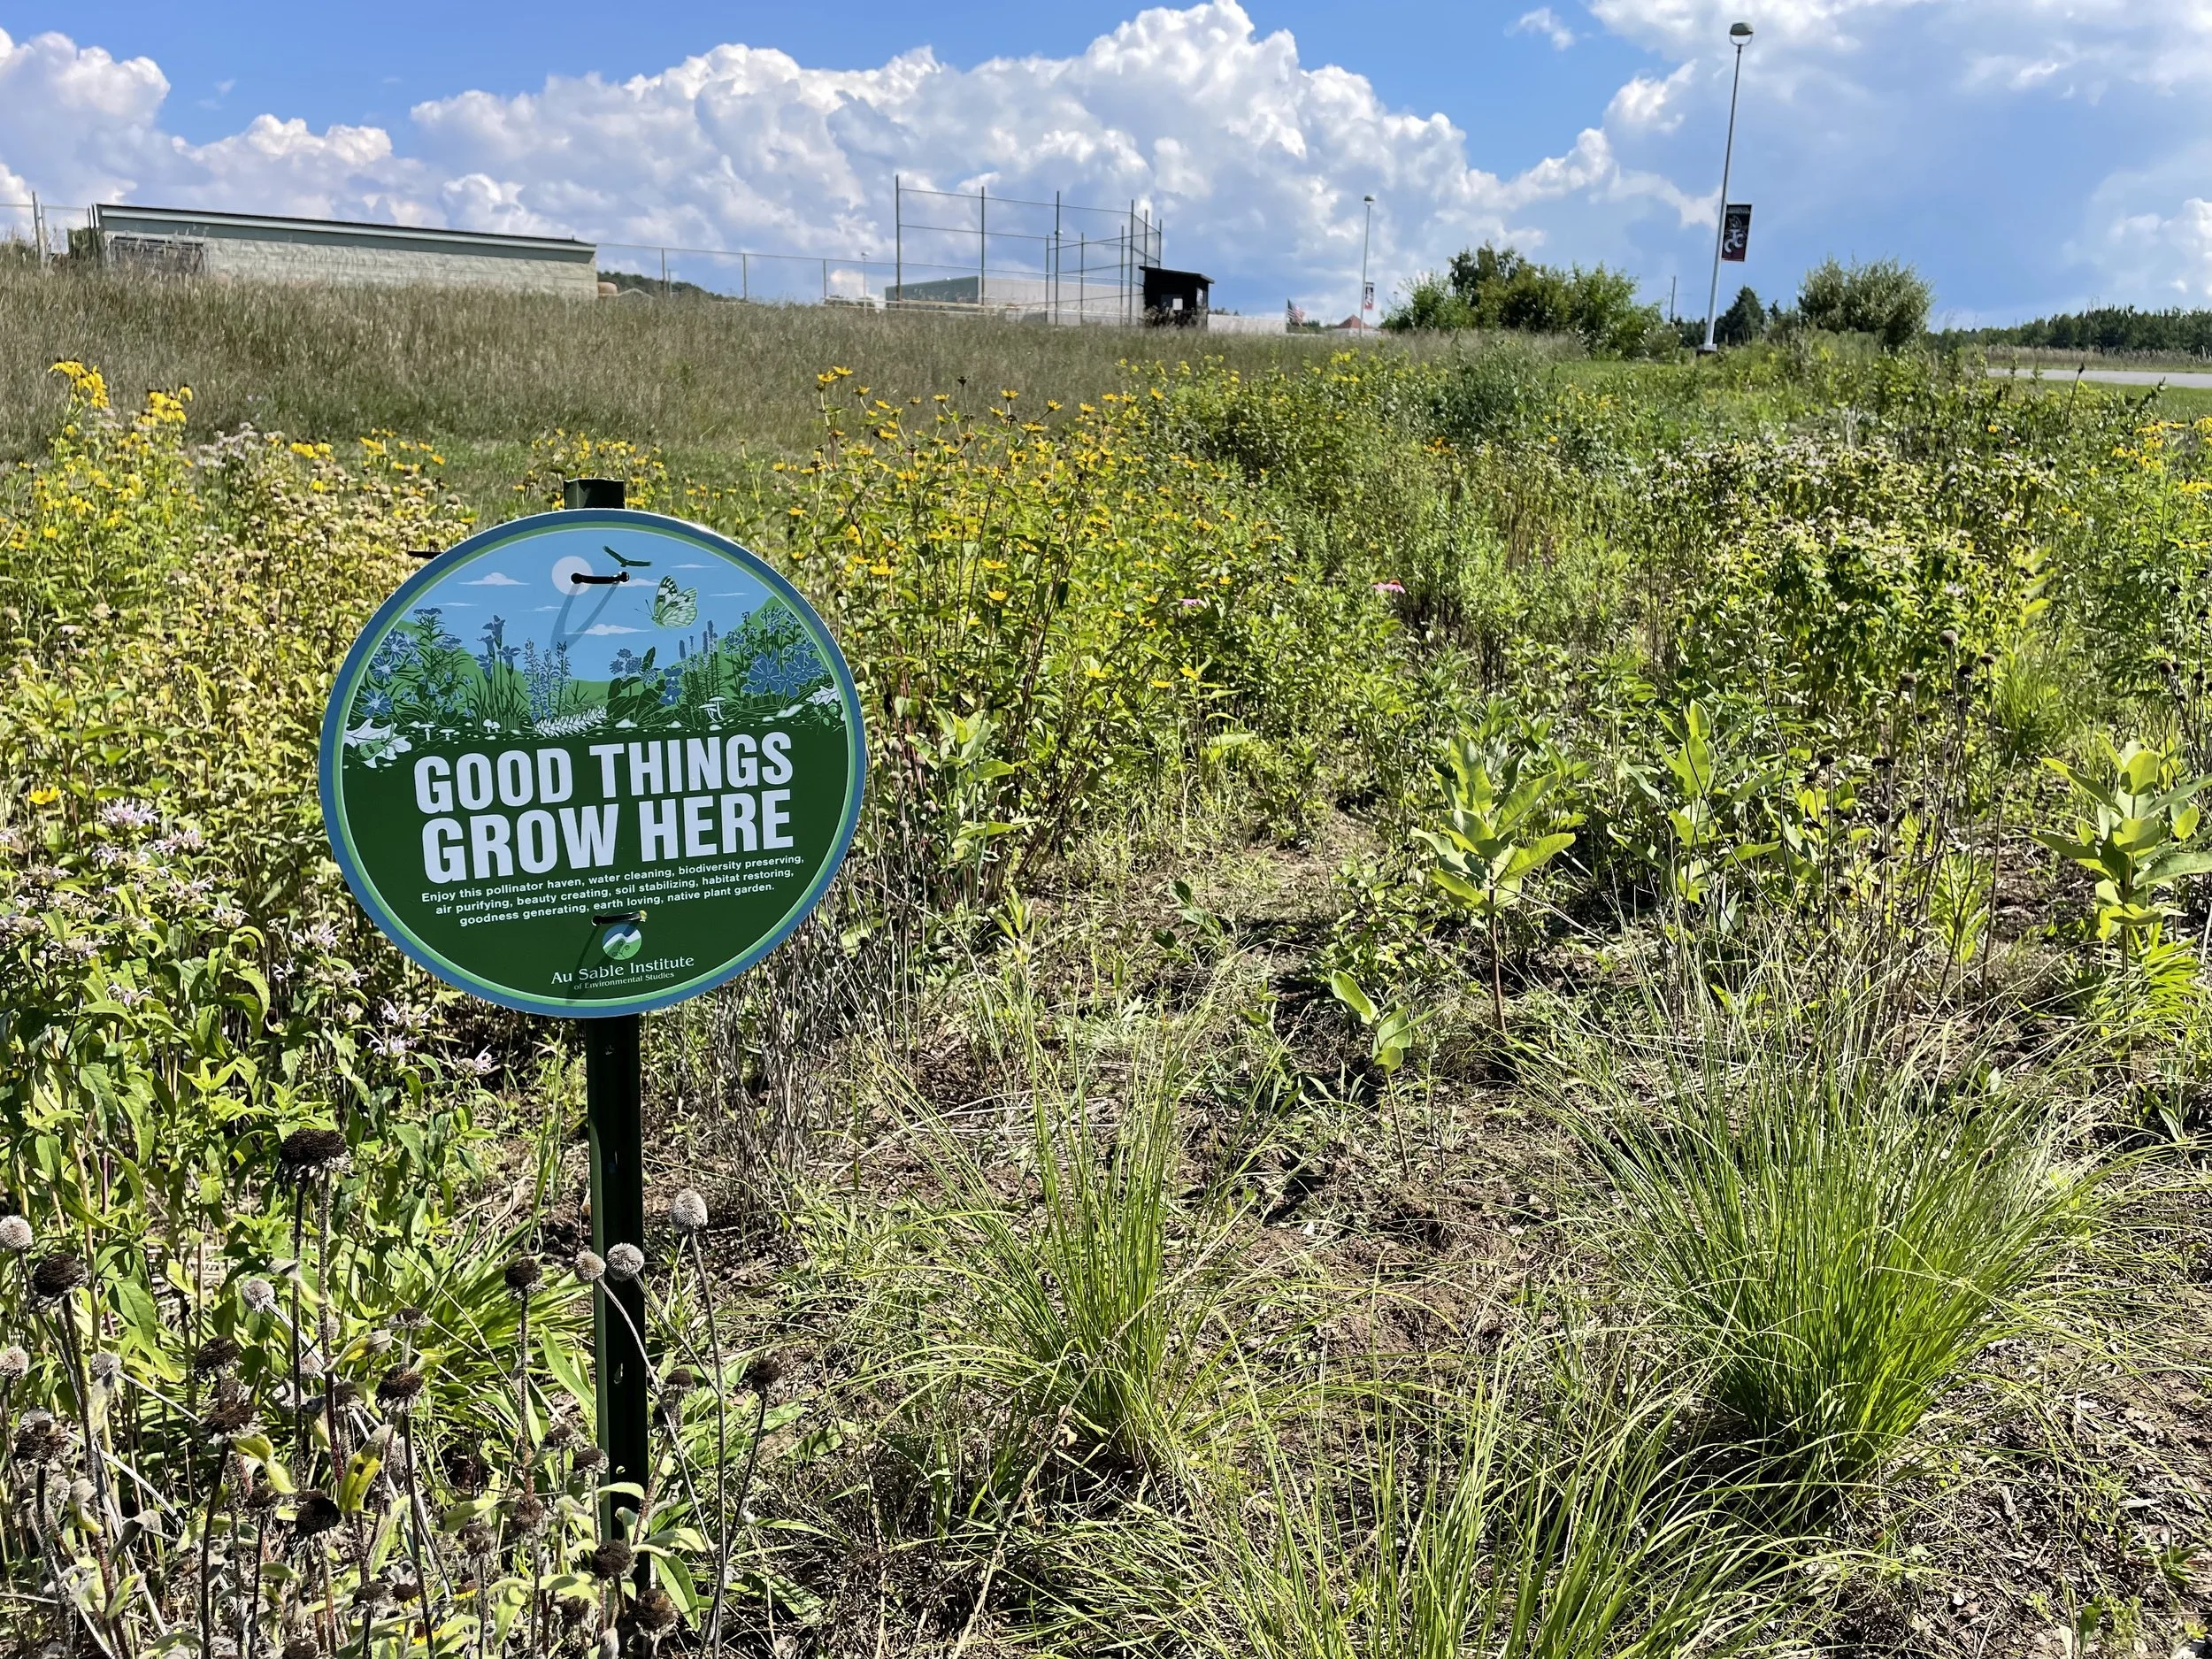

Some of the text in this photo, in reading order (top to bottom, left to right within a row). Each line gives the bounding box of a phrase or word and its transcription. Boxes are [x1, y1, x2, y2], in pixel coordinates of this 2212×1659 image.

[413, 732, 794, 814] GOOD THINGS
[421, 788, 794, 884] GROW HERE
[421, 855, 804, 902] Enjoy this pollinator haven, water cleaning, biodiversity preserving,
[435, 868, 795, 915] air purifying, beauty creating, soil stabilizing, habitat restoring,
[459, 883, 775, 927] goodness generating, earth loving, native plant garden.
[550, 956, 695, 985] Au Sable Institute
[584, 975, 643, 990] Environmental
[645, 972, 675, 982] Studies
